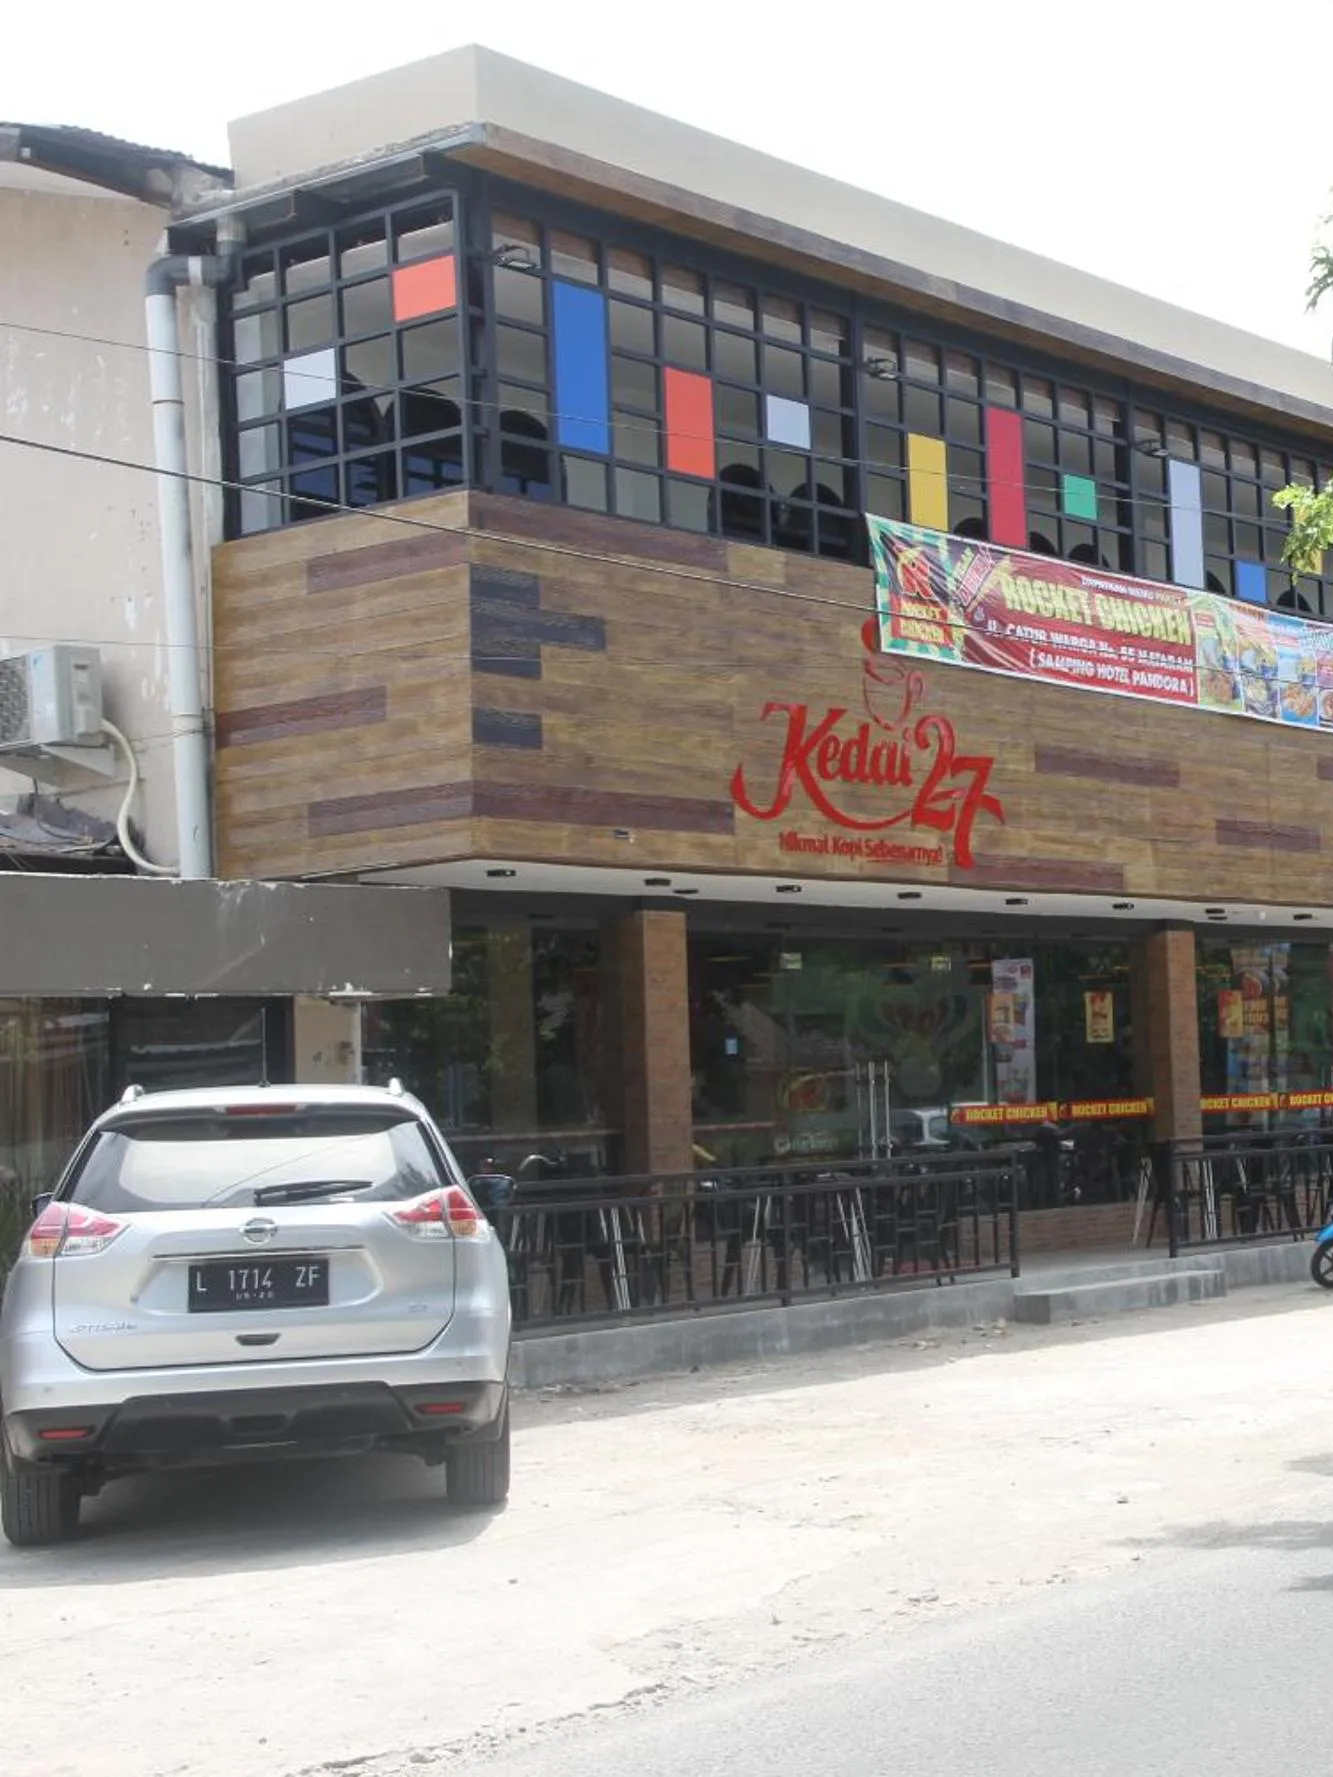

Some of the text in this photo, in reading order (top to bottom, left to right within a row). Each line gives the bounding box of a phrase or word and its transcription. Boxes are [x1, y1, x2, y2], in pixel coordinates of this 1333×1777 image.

[1002, 574, 1093, 626] ROCKET
[1094, 593, 1192, 645] CHICKEN
[1096, 661, 1130, 684] HOTEL
[730, 702, 1006, 871] Kedai 27
[966, 1105, 1048, 1121] ROCKET CHICKEN
[196, 1265, 321, 1292] L 1714 ZF
